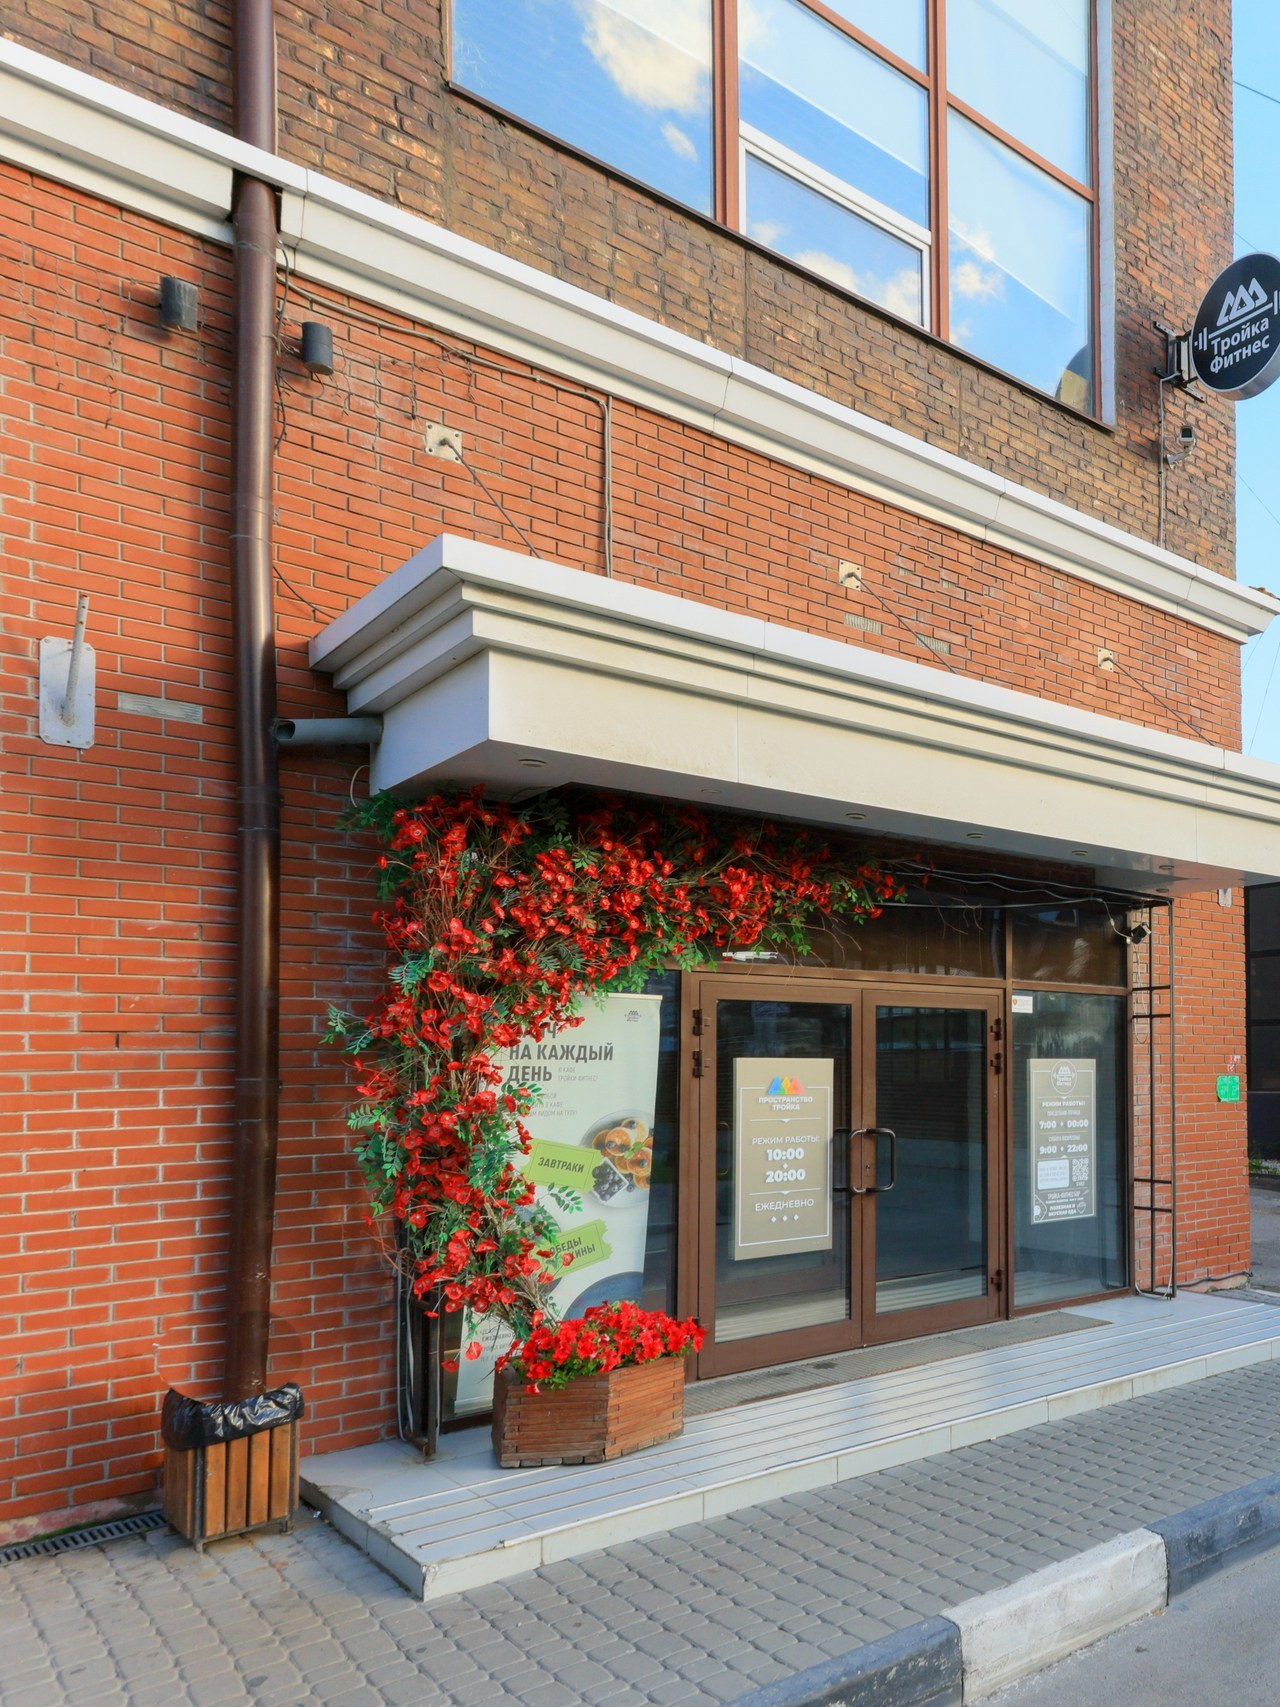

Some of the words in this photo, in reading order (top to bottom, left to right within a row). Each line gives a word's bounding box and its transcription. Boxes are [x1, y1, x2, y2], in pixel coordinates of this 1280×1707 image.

[1210, 317, 1269, 356] Тройка
[1210, 335, 1269, 374] Фитнес
[509, 1044, 532, 1060] НА
[537, 1042, 613, 1063] КАЖДЫЙ
[508, 1066, 552, 1084] ДЕНЬ
[758, 1096, 813, 1104] ПРОСТРАНСТВО
[772, 1102, 801, 1111] ТРОЙКА
[1039, 1121, 1057, 1129] 7:00
[1067, 1119, 1089, 1128] 00:00
[752, 1137, 783, 1145] РЕЖИМ
[784, 1135, 820, 1144] РАБОТЫ:
[766, 1148, 805, 1161] 10:00
[1039, 1145, 1057, 1154] 9:00
[1067, 1144, 1088, 1153] 22:00
[538, 1157, 585, 1174] ЗАВТРАКИ
[765, 1168, 806, 1183] 20:00
[755, 1198, 814, 1212] ЕЖЕДНЕВНО
